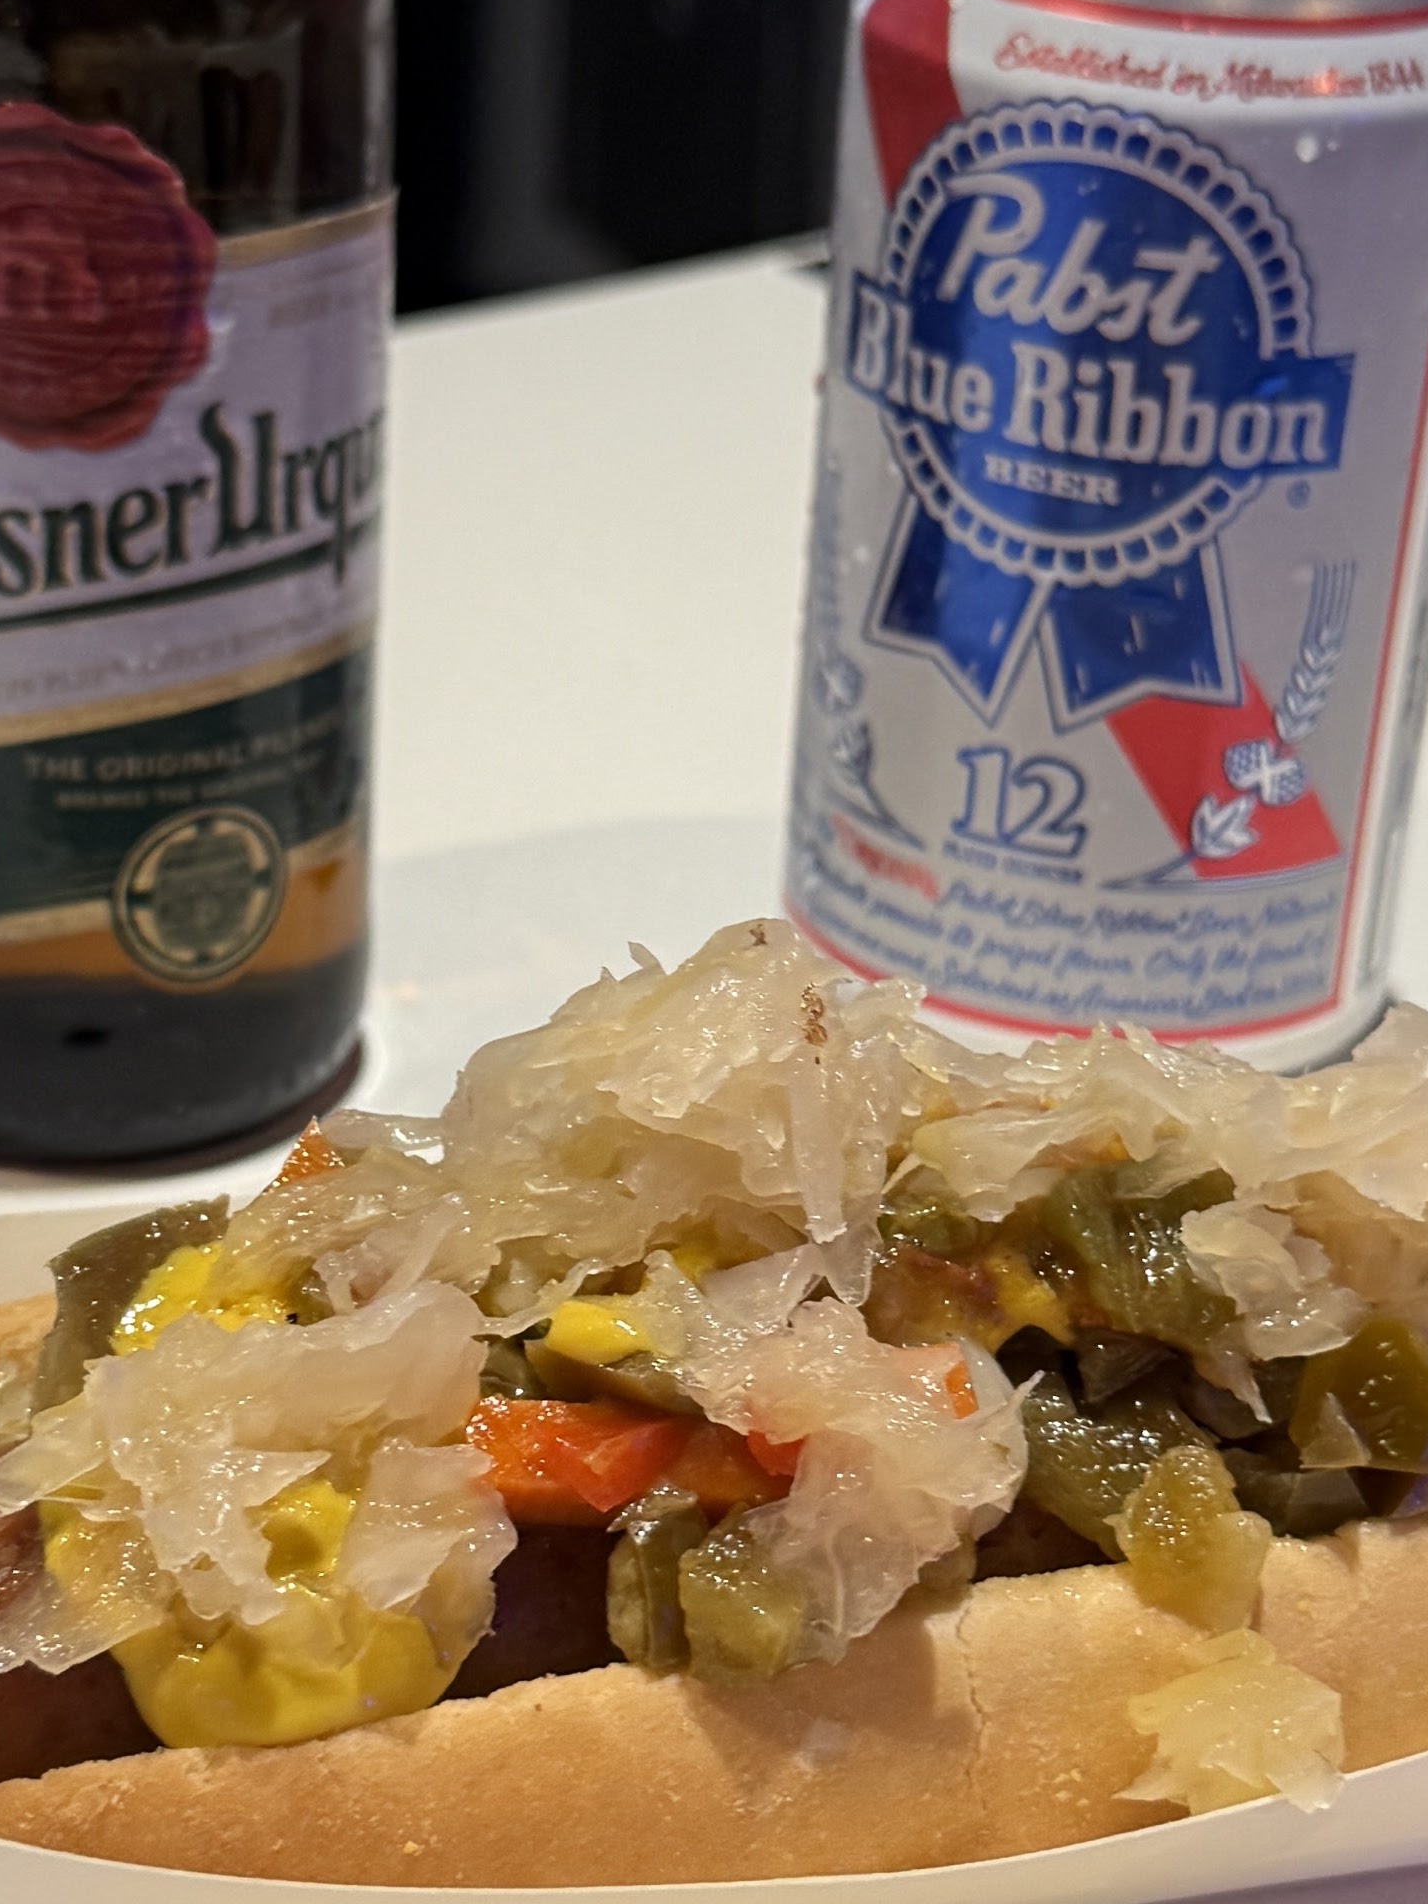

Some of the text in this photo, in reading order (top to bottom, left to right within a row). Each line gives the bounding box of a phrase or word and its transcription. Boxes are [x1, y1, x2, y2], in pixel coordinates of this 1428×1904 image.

[994, 31, 1168, 91] Established
[1368, 57, 1426, 94] 1844
[935, 171, 1223, 348] Pabst
[853, 288, 995, 434] Blue
[1000, 340, 1328, 470] Ribbon
[983, 452, 1122, 507] BEER
[22, 751, 89, 783] THE
[95, 737, 246, 783] ORIGINAL
[951, 744, 1088, 859] 12
